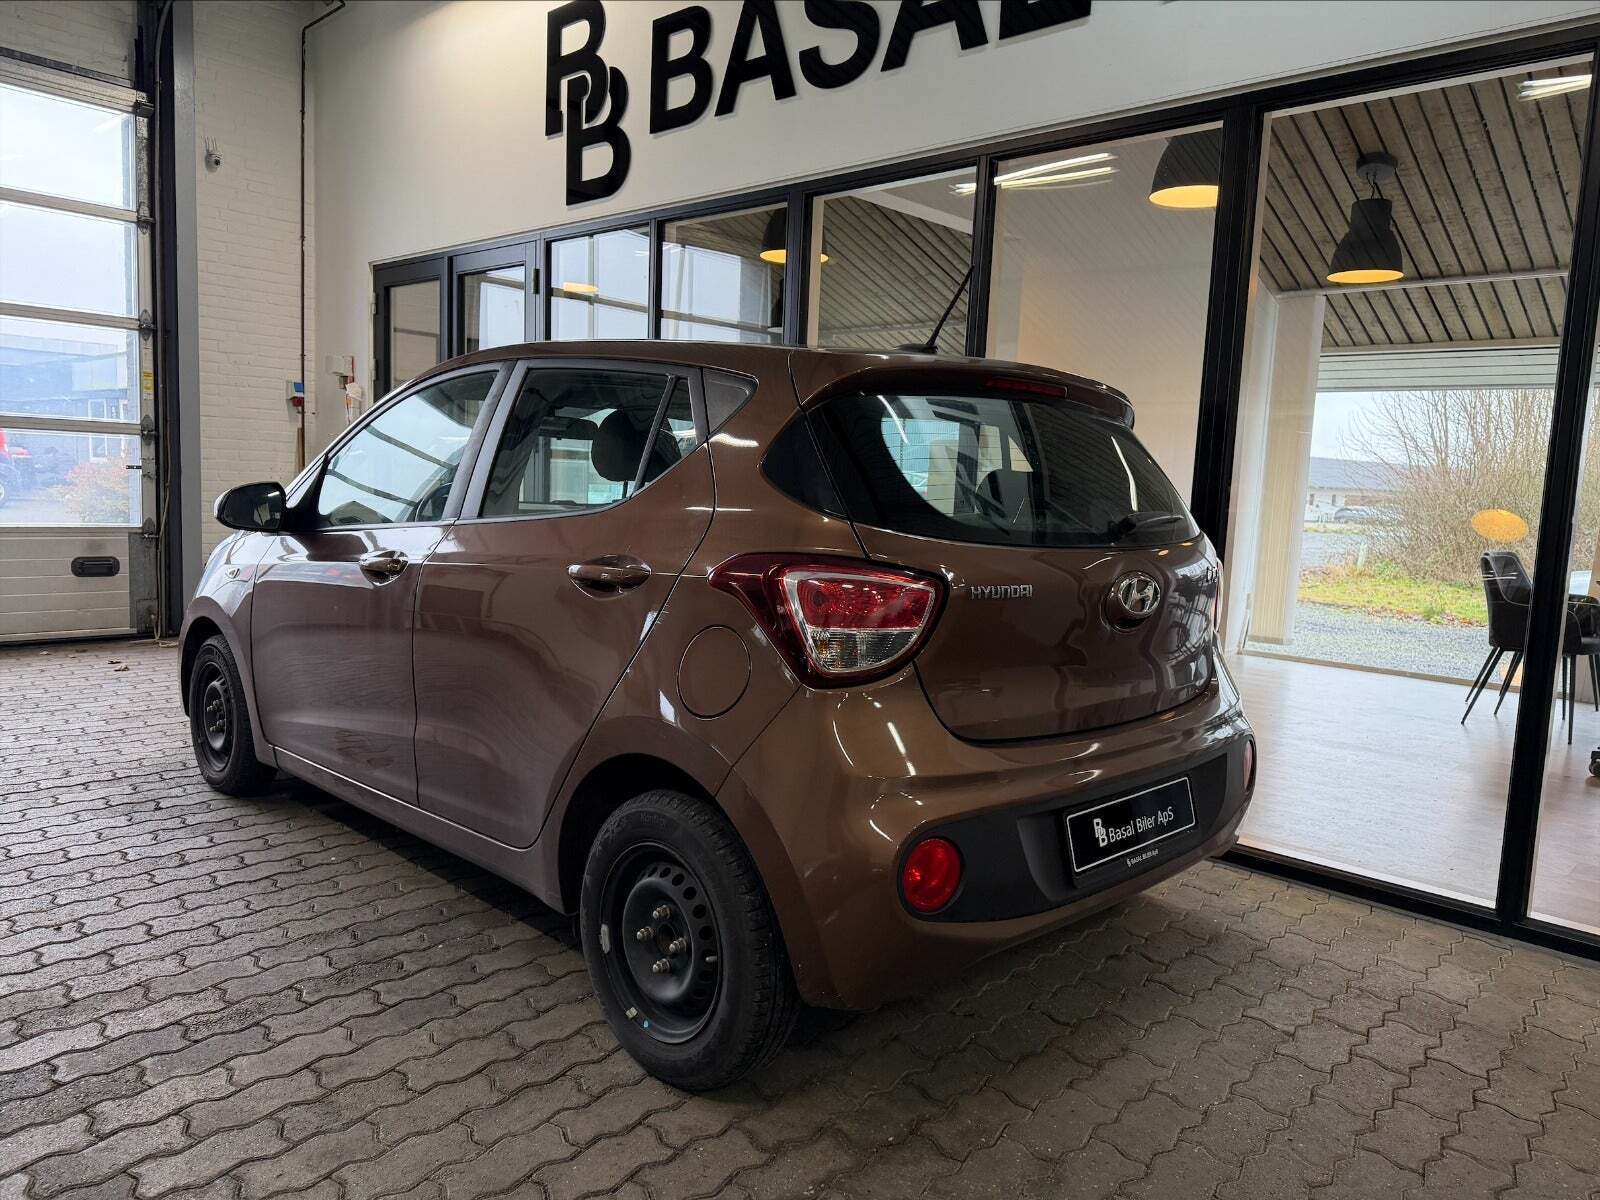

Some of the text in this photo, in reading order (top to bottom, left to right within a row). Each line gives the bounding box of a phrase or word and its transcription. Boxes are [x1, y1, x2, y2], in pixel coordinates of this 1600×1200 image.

[650, 0, 1091, 134] BASA
[969, 584, 1033, 600] HYUNDAI
[1108, 820, 1135, 843] Basal
[1136, 815, 1156, 833] Biler
[1157, 806, 1174, 826] ApS
